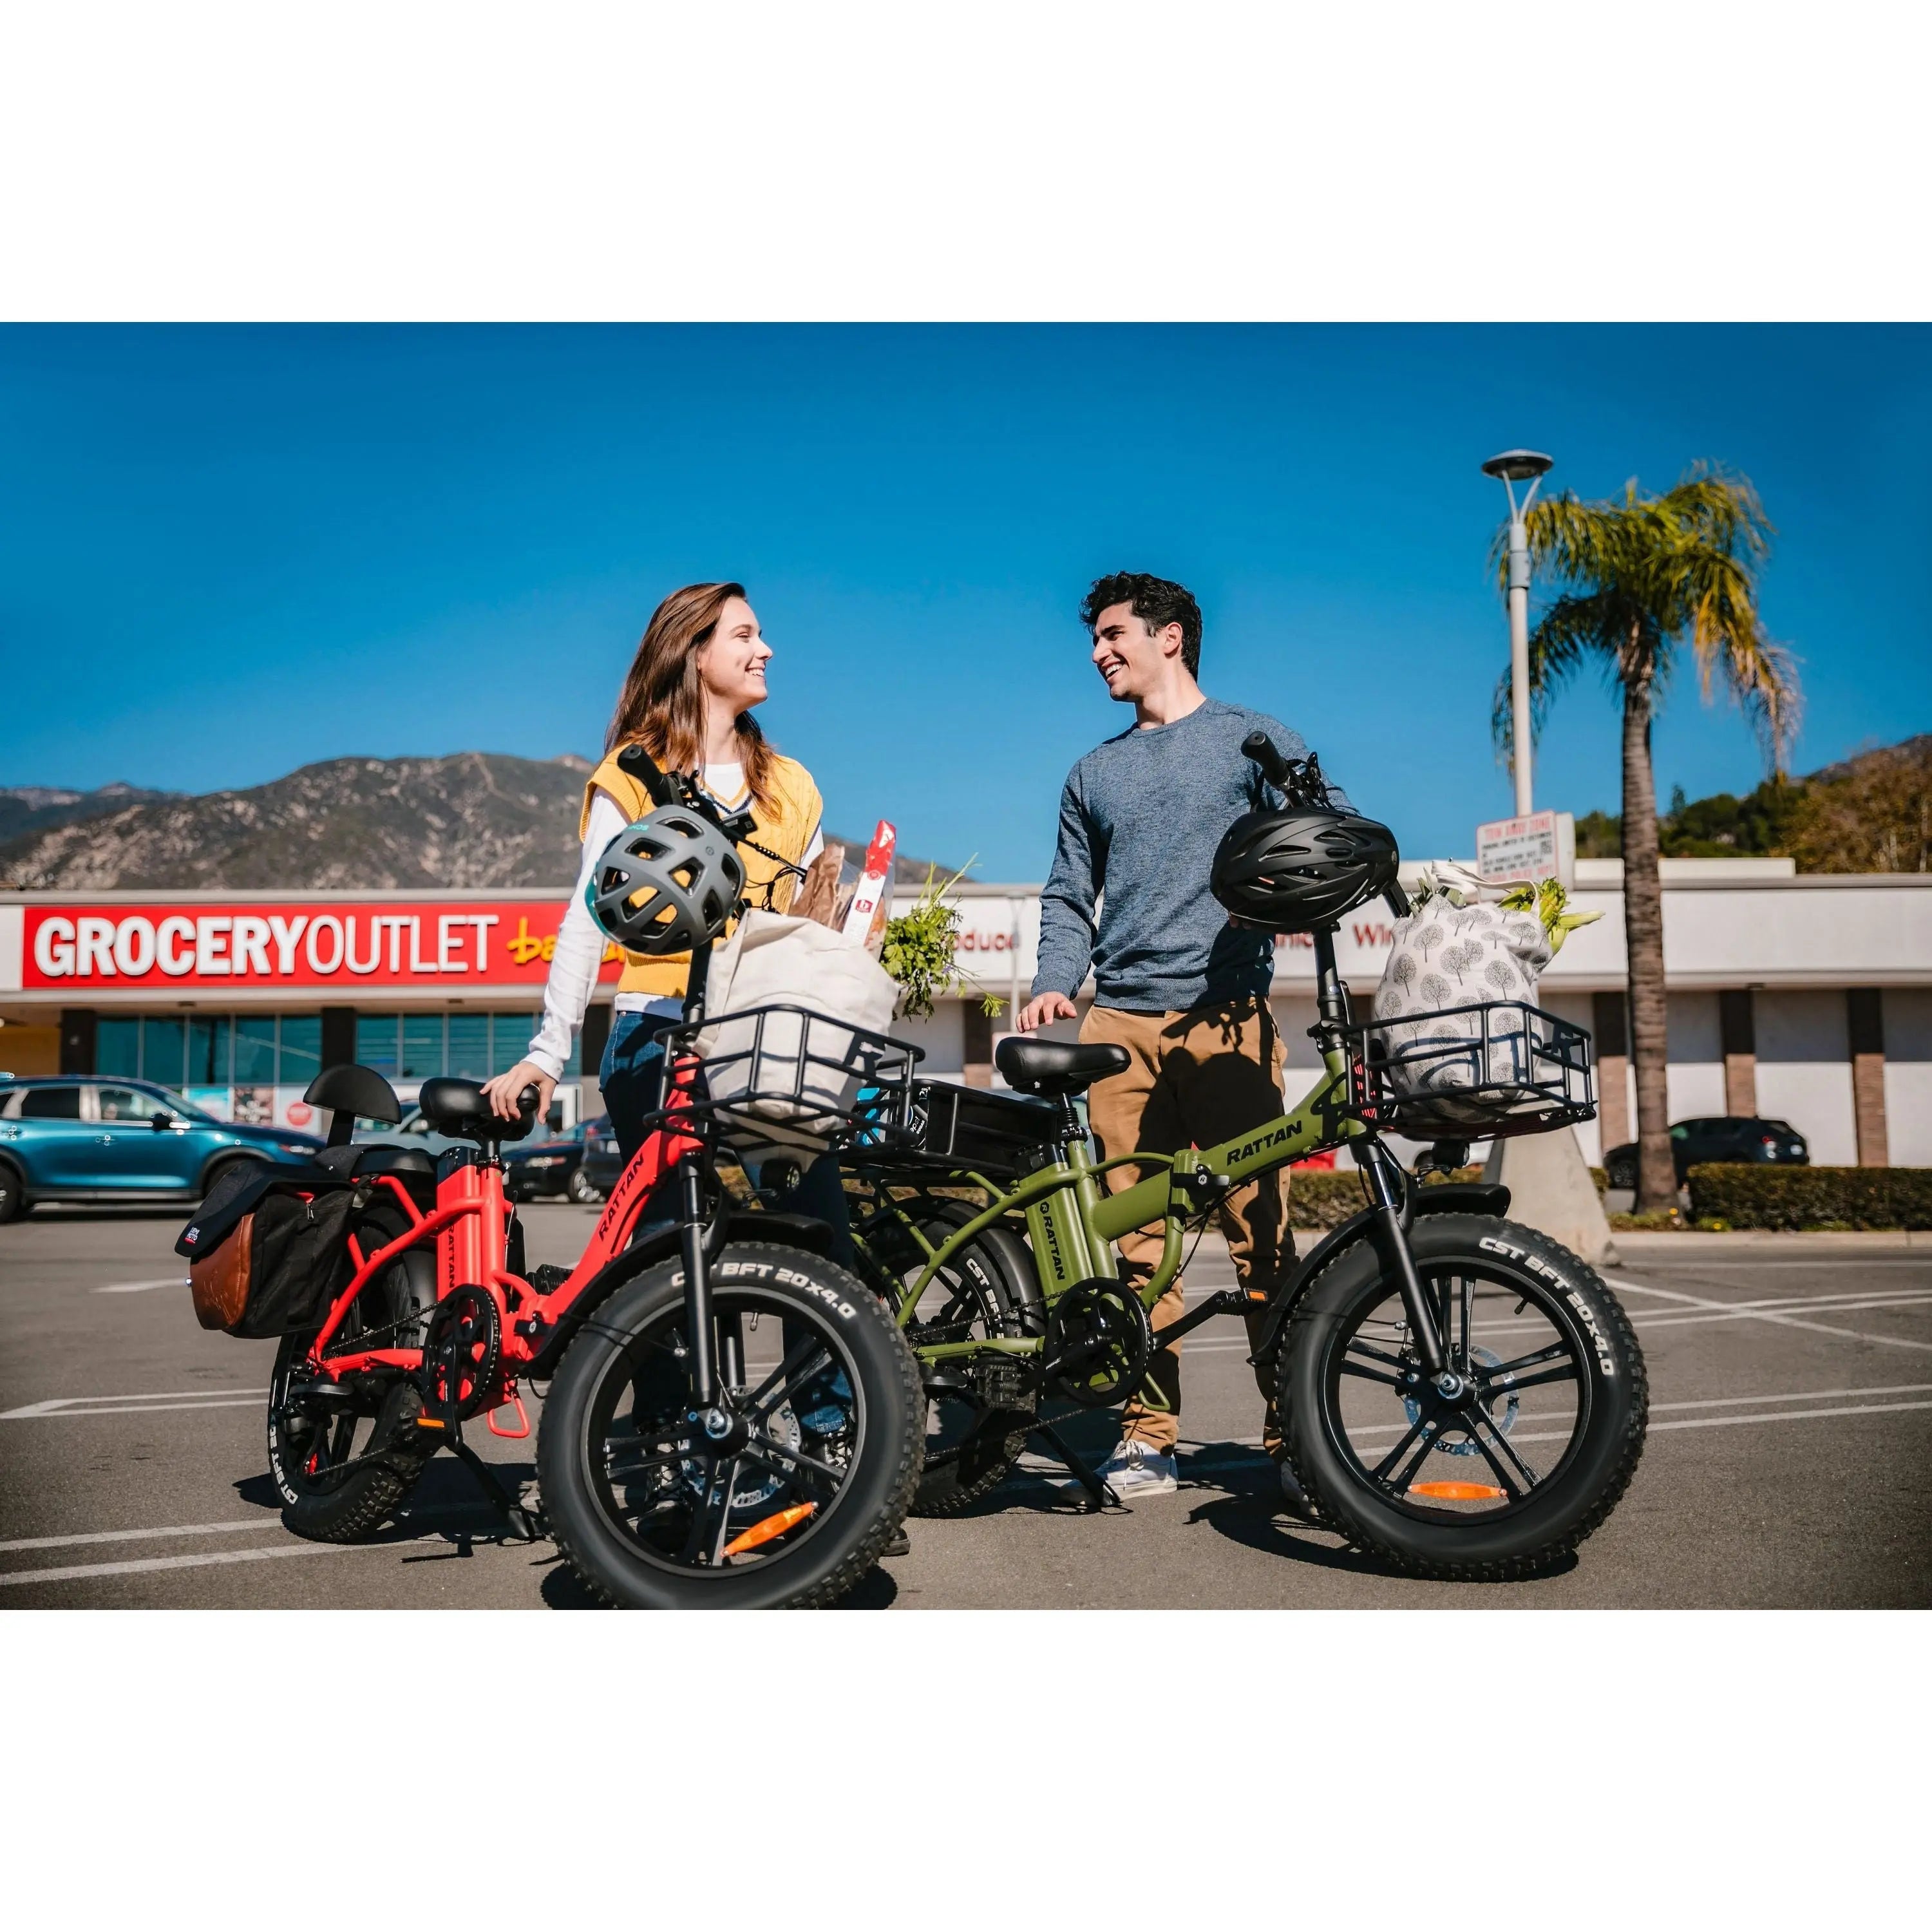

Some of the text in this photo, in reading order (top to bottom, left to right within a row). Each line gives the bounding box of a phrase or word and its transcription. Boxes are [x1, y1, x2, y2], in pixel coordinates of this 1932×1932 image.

[1227, 1121, 1302, 1166] RATTAN
[599, 1153, 644, 1242] RATTAN
[1043, 1217, 1065, 1280] RATTAN
[1479, 1236, 1525, 1260] CST
[1524, 1256, 1570, 1289] BFT
[721, 1262, 773, 1277] BFT
[966, 1258, 990, 1285] CST
[271, 1453, 285, 1484] BFT
[280, 1484, 299, 1505] CST
